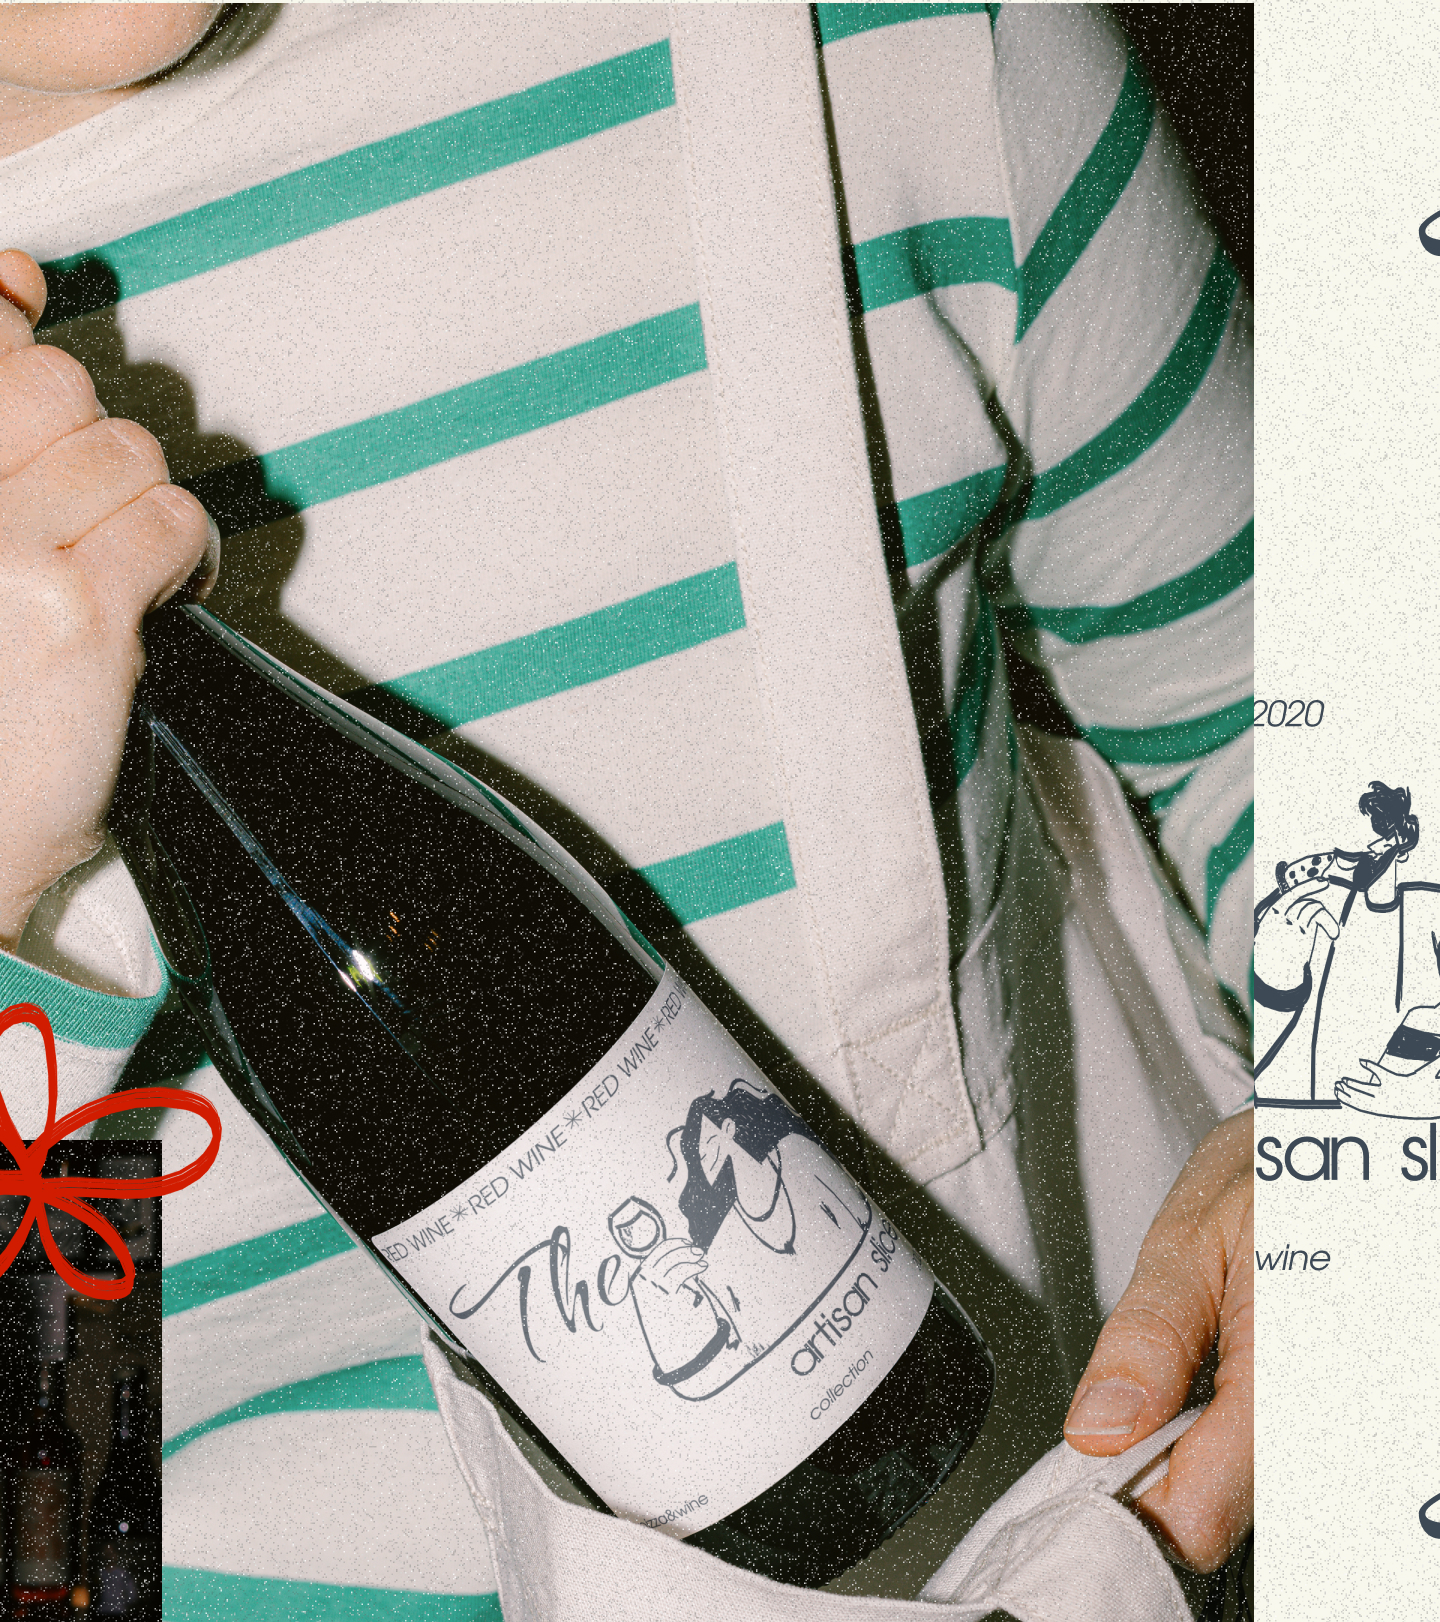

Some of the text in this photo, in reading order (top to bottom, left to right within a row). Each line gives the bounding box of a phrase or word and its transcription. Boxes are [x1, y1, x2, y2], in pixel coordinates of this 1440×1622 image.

[406, 1215, 454, 1252] WINE
[467, 1176, 509, 1215] RED
[509, 1124, 568, 1180] WINE
[581, 1074, 619, 1118] RED
[617, 1026, 659, 1078] WINE
[660, 991, 682, 1025] RED
[449, 1225, 630, 1363] The
[790, 1219, 898, 1376] artisan slice
[810, 1350, 874, 1420] collection
[639, 1494, 709, 1529] izza&wine
